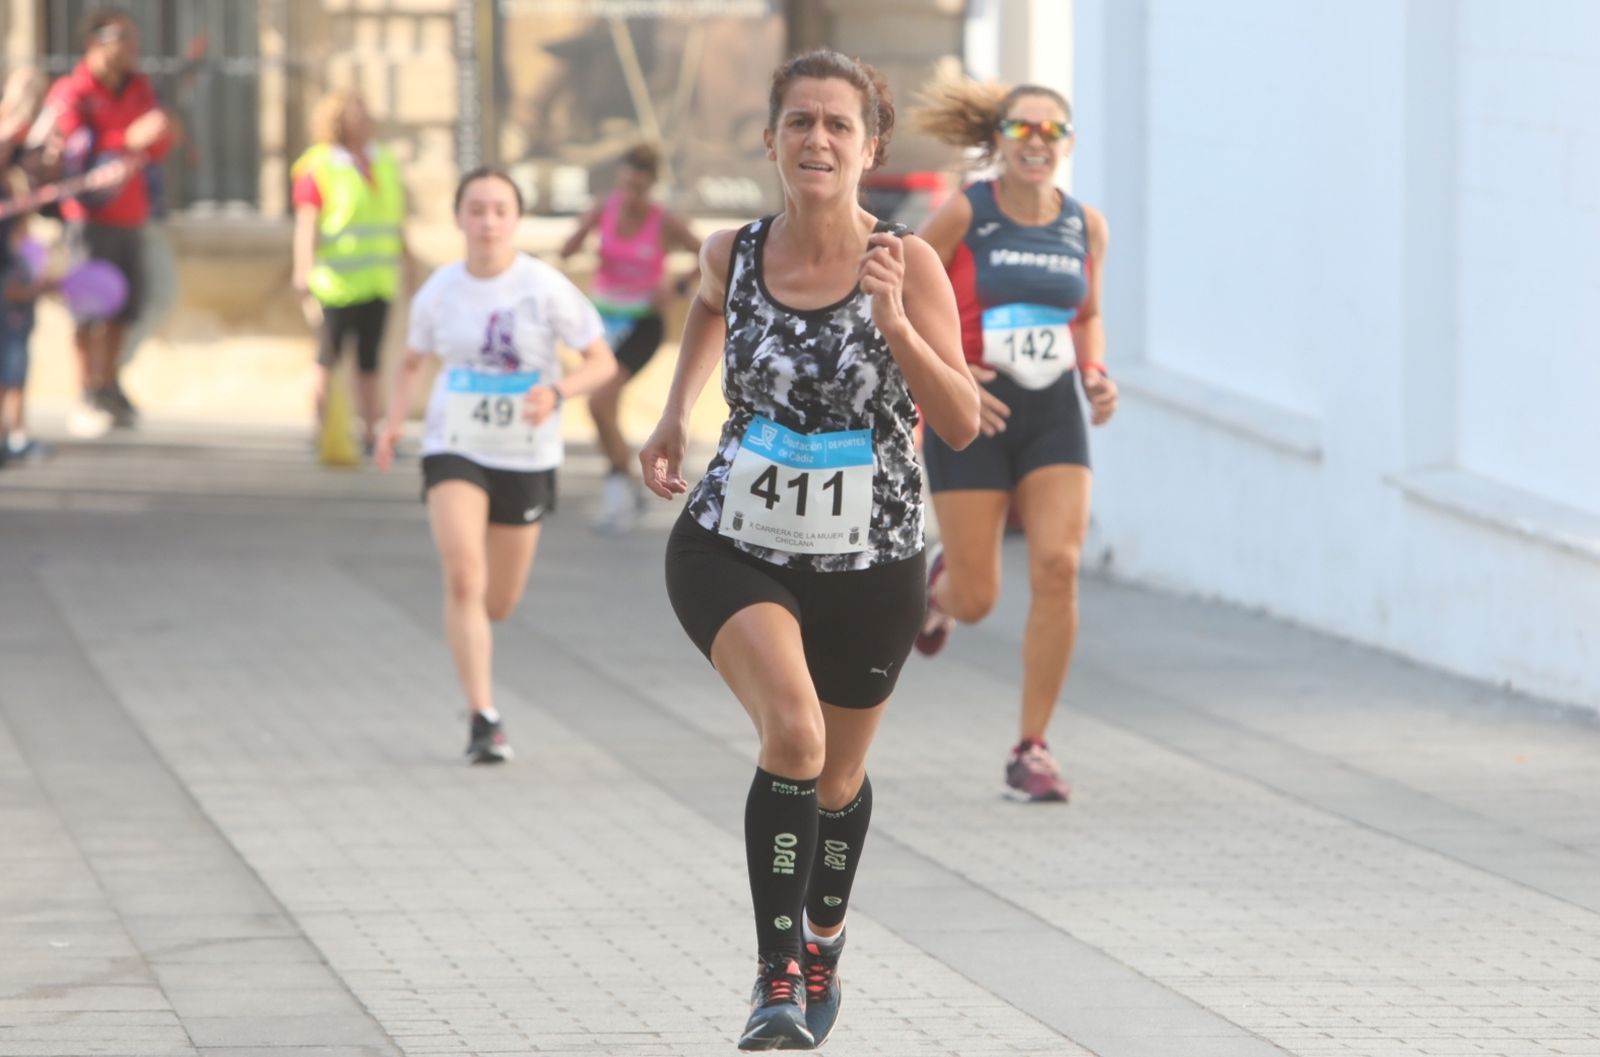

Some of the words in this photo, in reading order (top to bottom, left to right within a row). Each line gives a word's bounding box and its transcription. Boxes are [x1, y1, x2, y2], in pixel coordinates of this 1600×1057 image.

[1004, 329, 1059, 361] 142
[472, 397, 514, 427] 49
[828, 437, 866, 449] DEPORTES
[778, 448, 788, 457] de
[750, 465, 843, 516] 411
[755, 524, 792, 537] CARRERA
[793, 531, 804, 539] DE
[806, 532, 816, 540] LA
[817, 532, 844, 540] MUJER
[775, 536, 814, 547] CHICLANA
[772, 781, 798, 791] PRO
